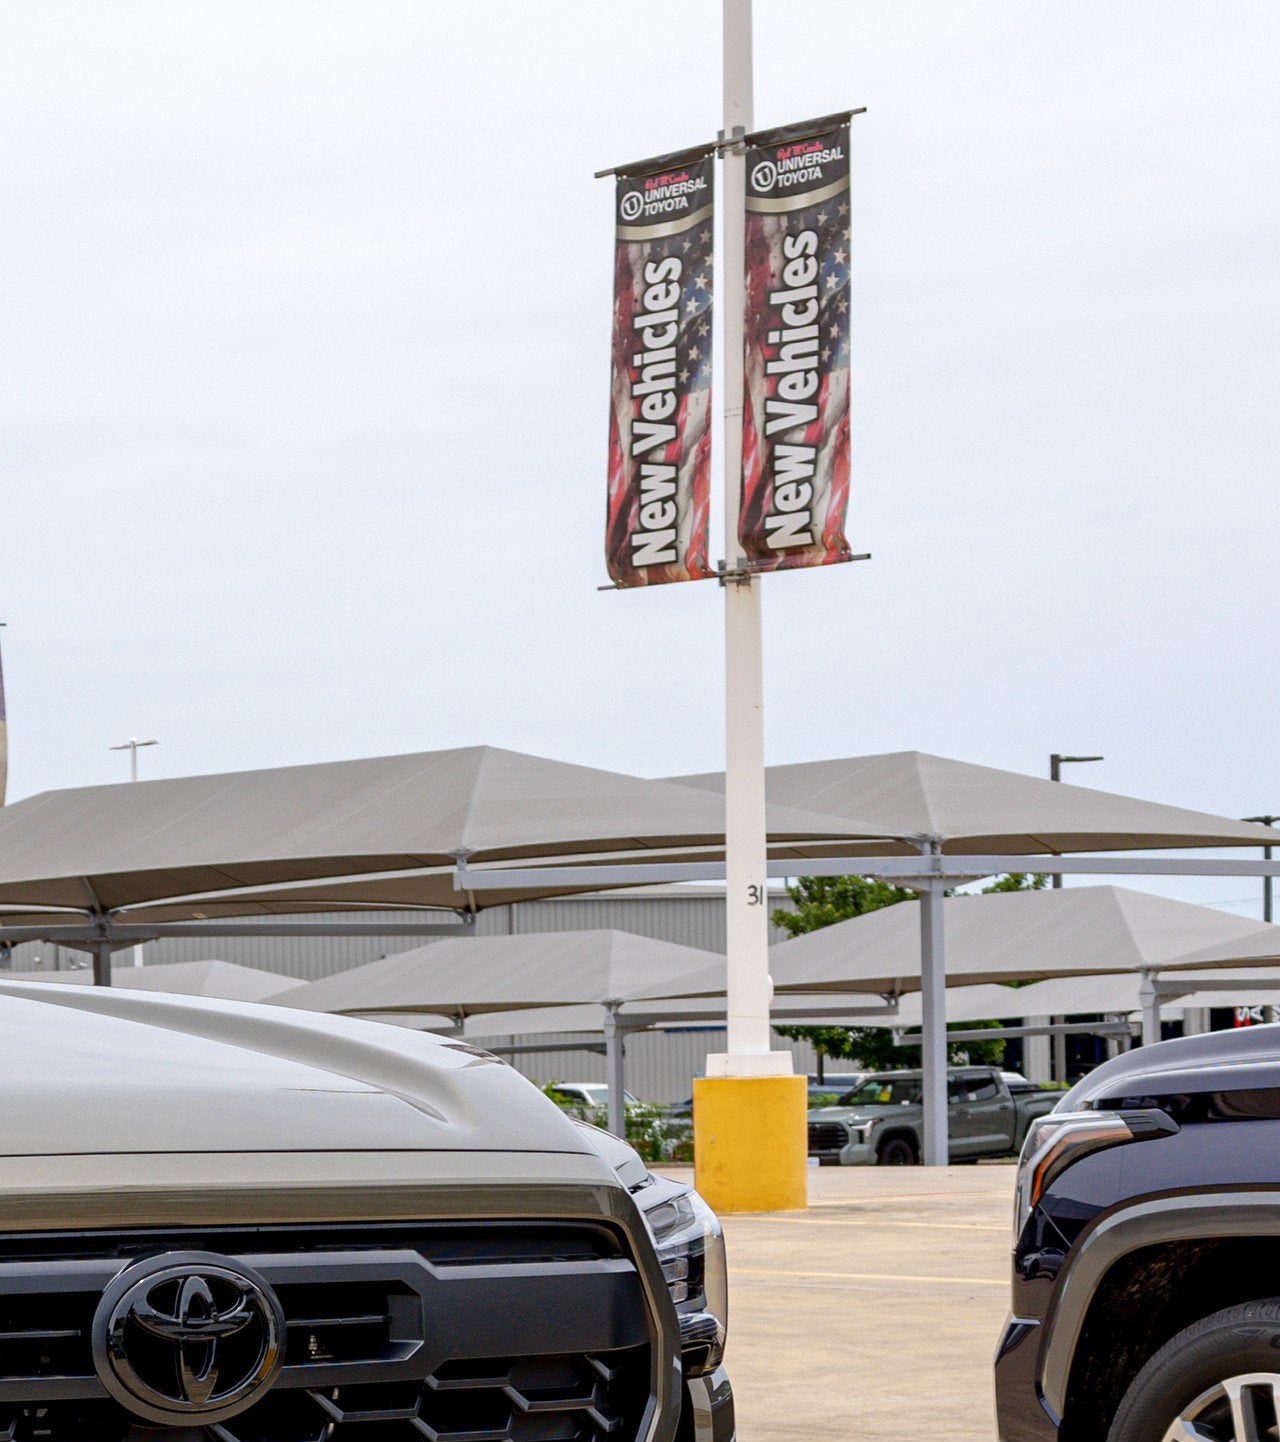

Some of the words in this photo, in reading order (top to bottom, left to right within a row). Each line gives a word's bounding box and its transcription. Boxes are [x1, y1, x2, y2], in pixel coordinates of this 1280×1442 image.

[777, 146, 844, 173] UNIVERSAL
[644, 175, 708, 202] UNIVERSAL
[777, 166, 823, 187] TOYOTA
[644, 195, 689, 216] TOYOTA
[766, 229, 820, 437] Vehicles
[632, 255, 683, 457] Vehicles
[766, 442, 817, 548] New
[632, 463, 678, 568] New
[747, 884, 763, 906] 31
